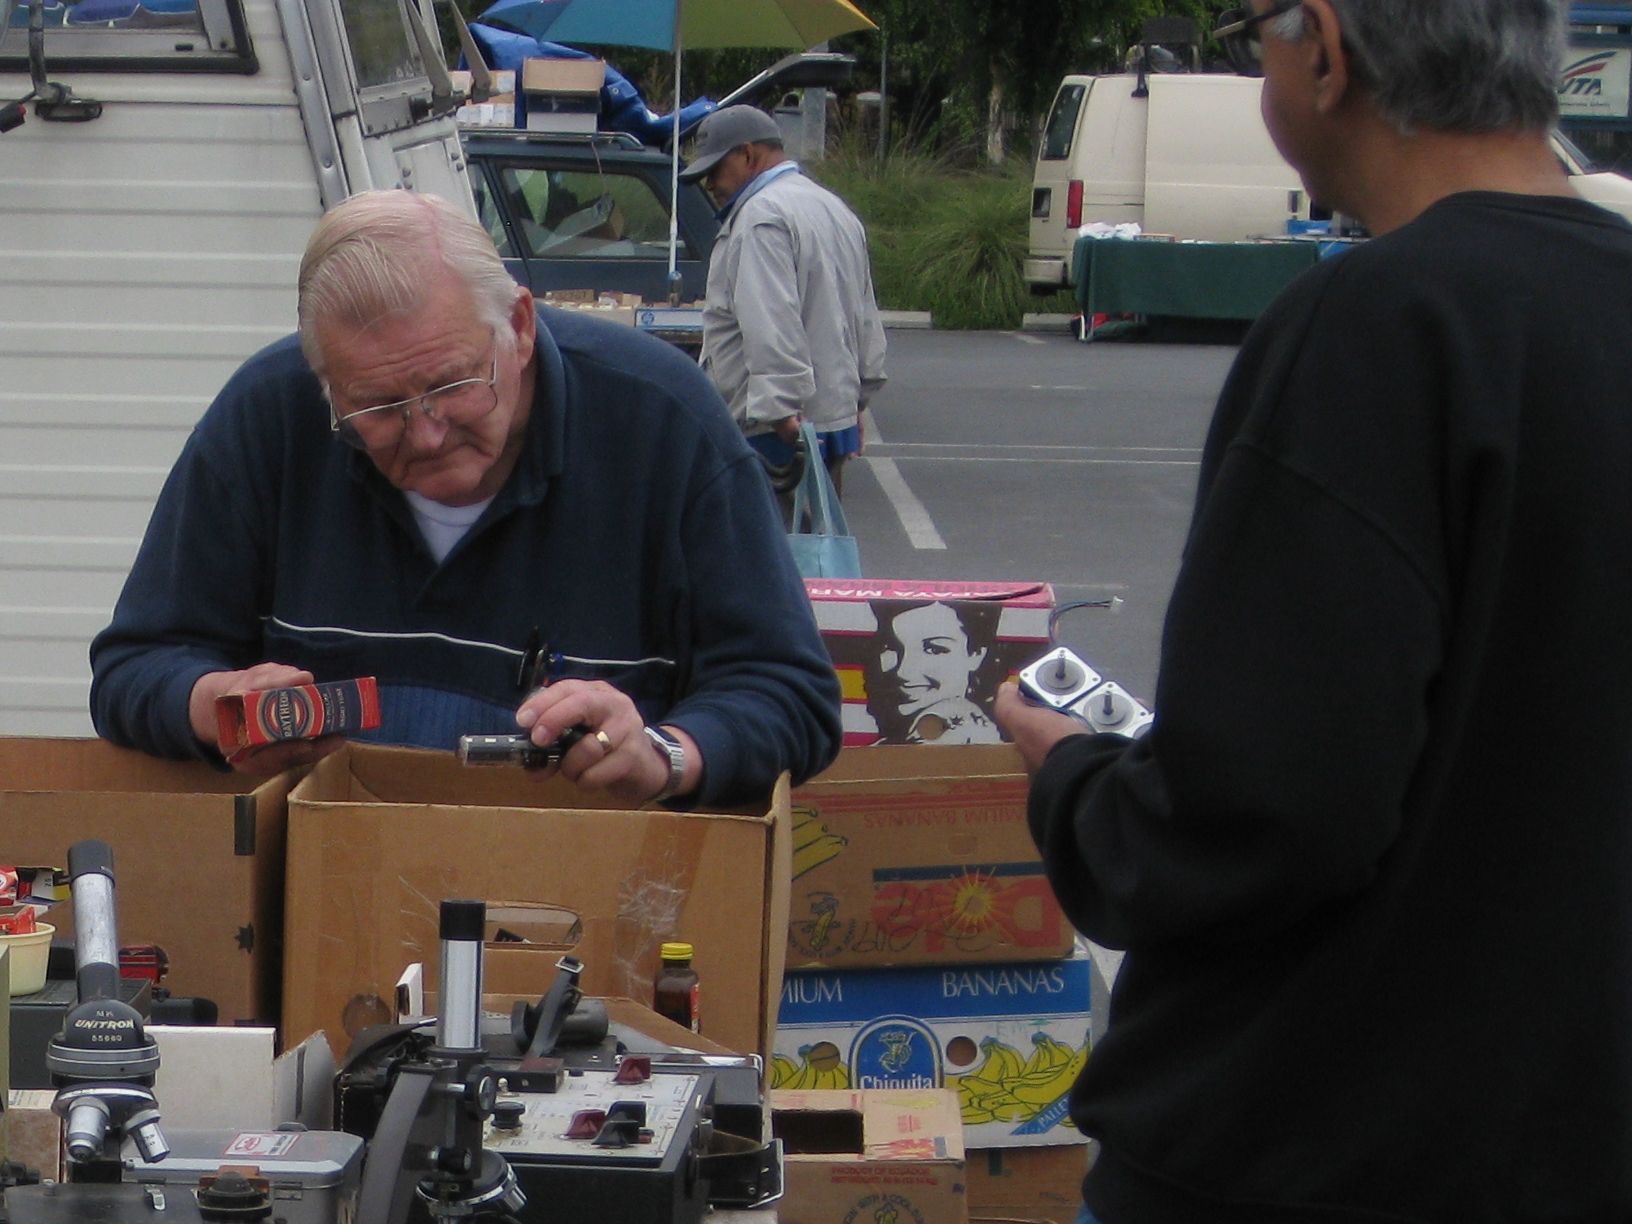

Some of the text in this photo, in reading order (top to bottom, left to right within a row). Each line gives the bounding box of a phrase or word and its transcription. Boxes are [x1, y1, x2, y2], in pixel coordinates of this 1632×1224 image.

[864, 809, 957, 830] BANANAS
[943, 968, 1066, 998] BANANAS
[75, 1019, 134, 1030] UNITRON
